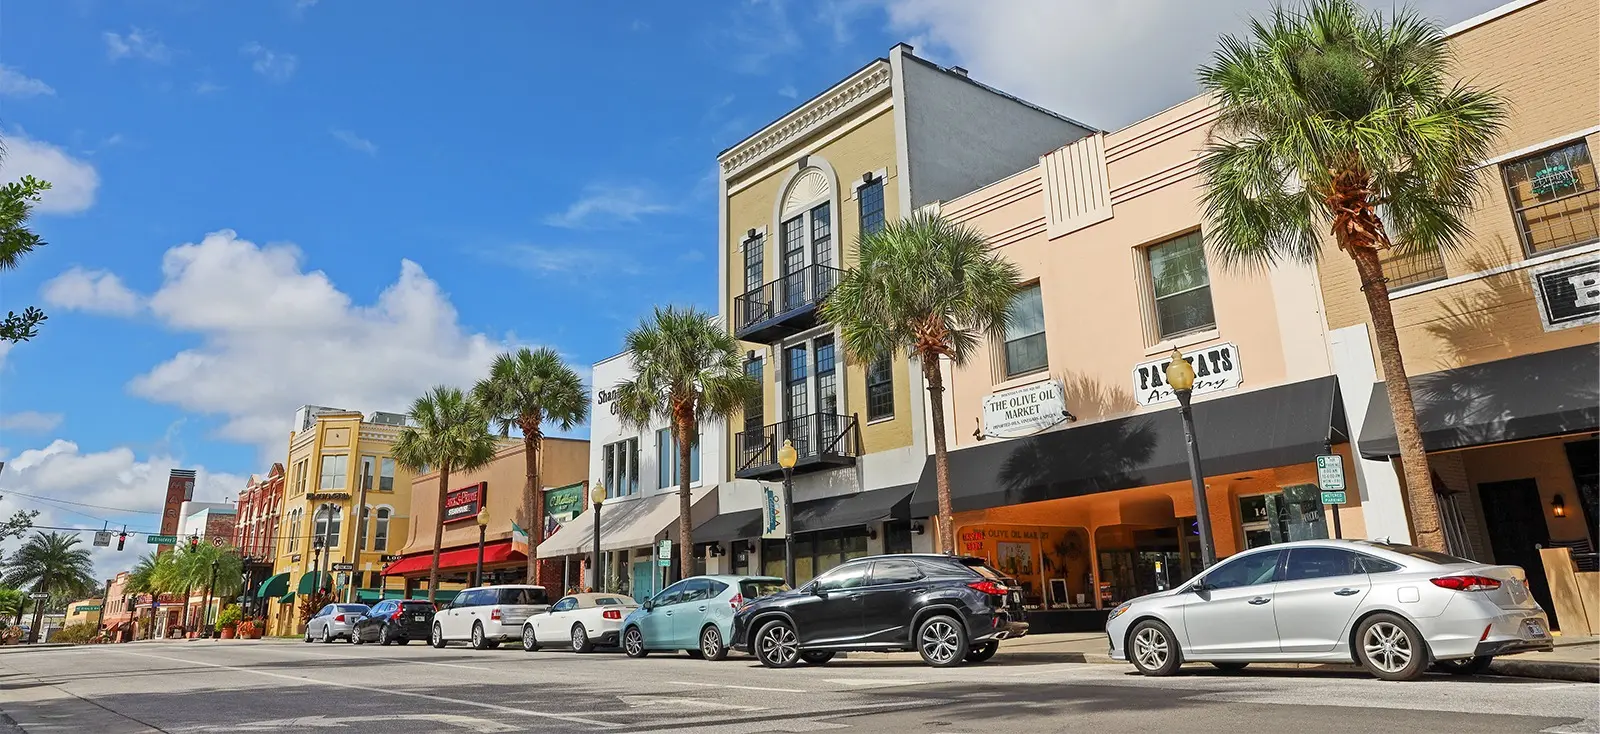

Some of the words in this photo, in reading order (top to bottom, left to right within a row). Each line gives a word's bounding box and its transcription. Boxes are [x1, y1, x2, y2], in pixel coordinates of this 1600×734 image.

[990, 400, 1008, 412] THE
[1009, 393, 1037, 408] OLIVE
[1039, 389, 1056, 401] OIL
[1005, 404, 1041, 420] MARKET
[1320, 458, 1325, 467] 3
[1254, 507, 1267, 517] 14
[988, 529, 1009, 538] OLIVE
[1011, 530, 1022, 538] OIL
[1024, 531, 1049, 540] MARET
